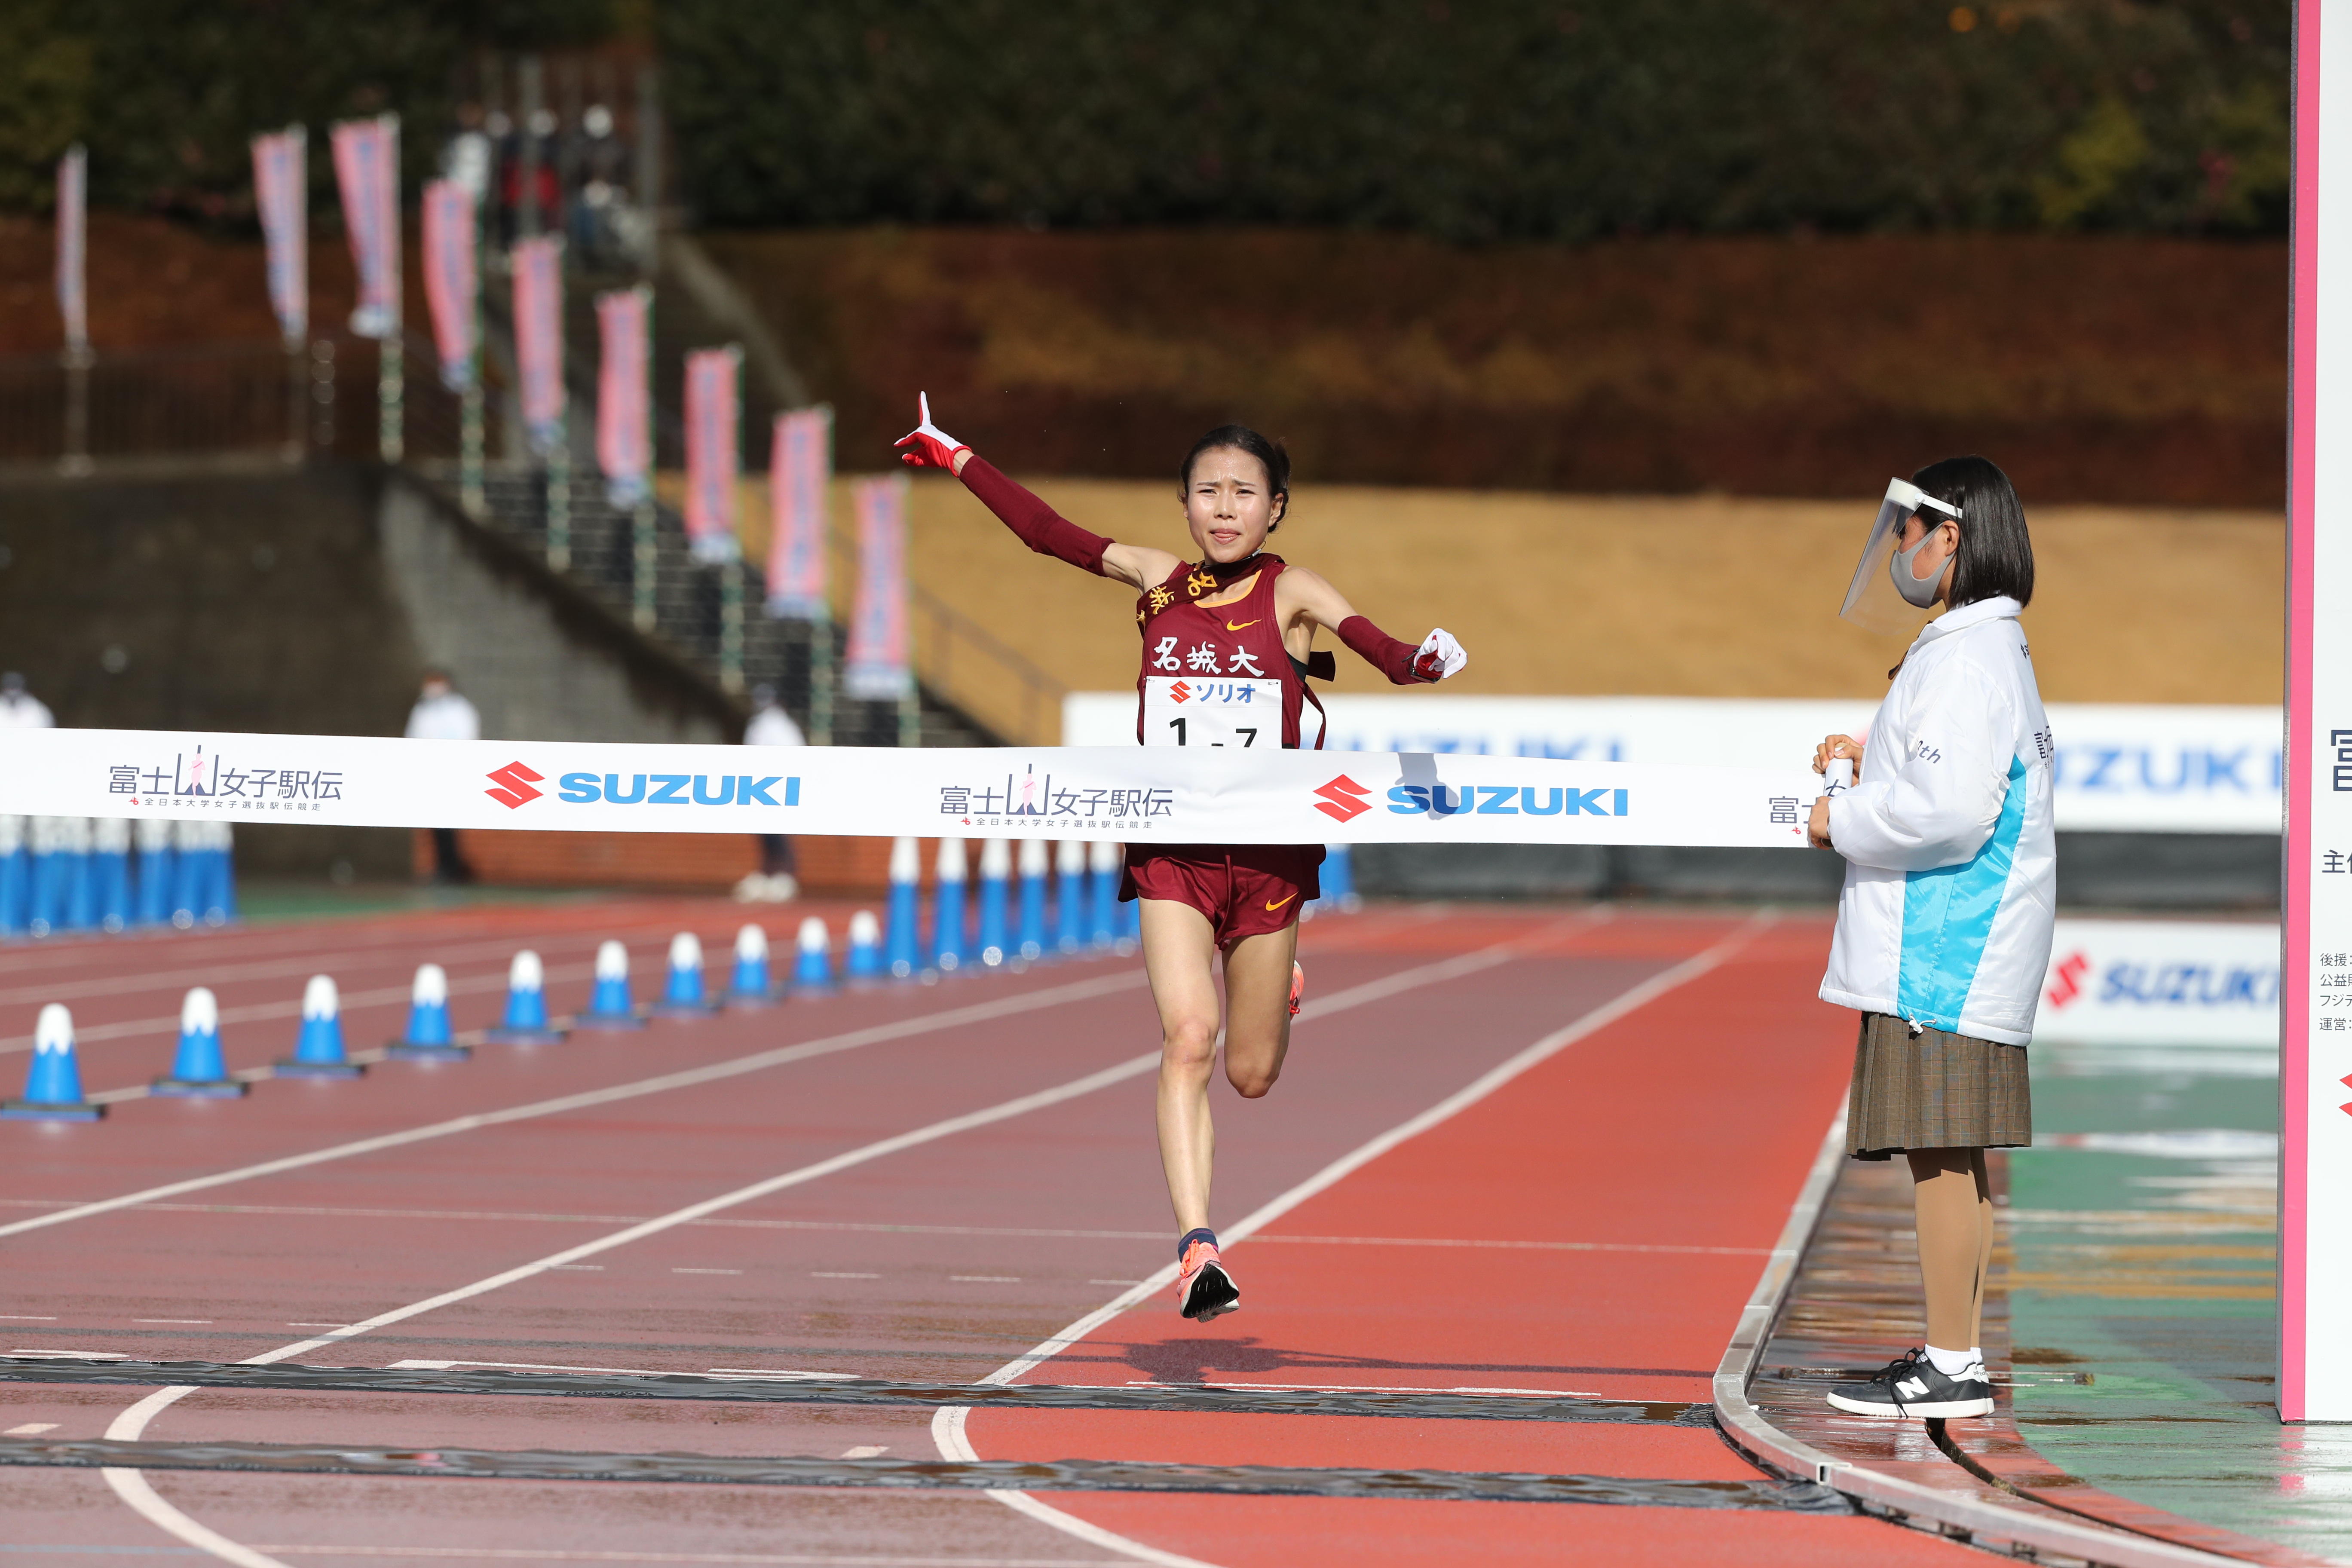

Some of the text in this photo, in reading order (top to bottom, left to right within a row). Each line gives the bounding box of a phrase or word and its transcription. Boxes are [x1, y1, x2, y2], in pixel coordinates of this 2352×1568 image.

[1152, 636, 1265, 677] 名城大
[1197, 683, 1256, 703] ソリオ
[109, 744, 343, 800] 富士山女子駅伝
[145, 797, 321, 812] 全日本大学女子選抜駅伝競走
[558, 772, 800, 806] SUZUKI
[941, 763, 1173, 817] 富士山女子駅伝
[1387, 785, 1628, 816] SUZUKI
[976, 818, 1153, 829] 全日本大学女子選抜駅伝競走
[2322, 849, 2352, 874] 主
